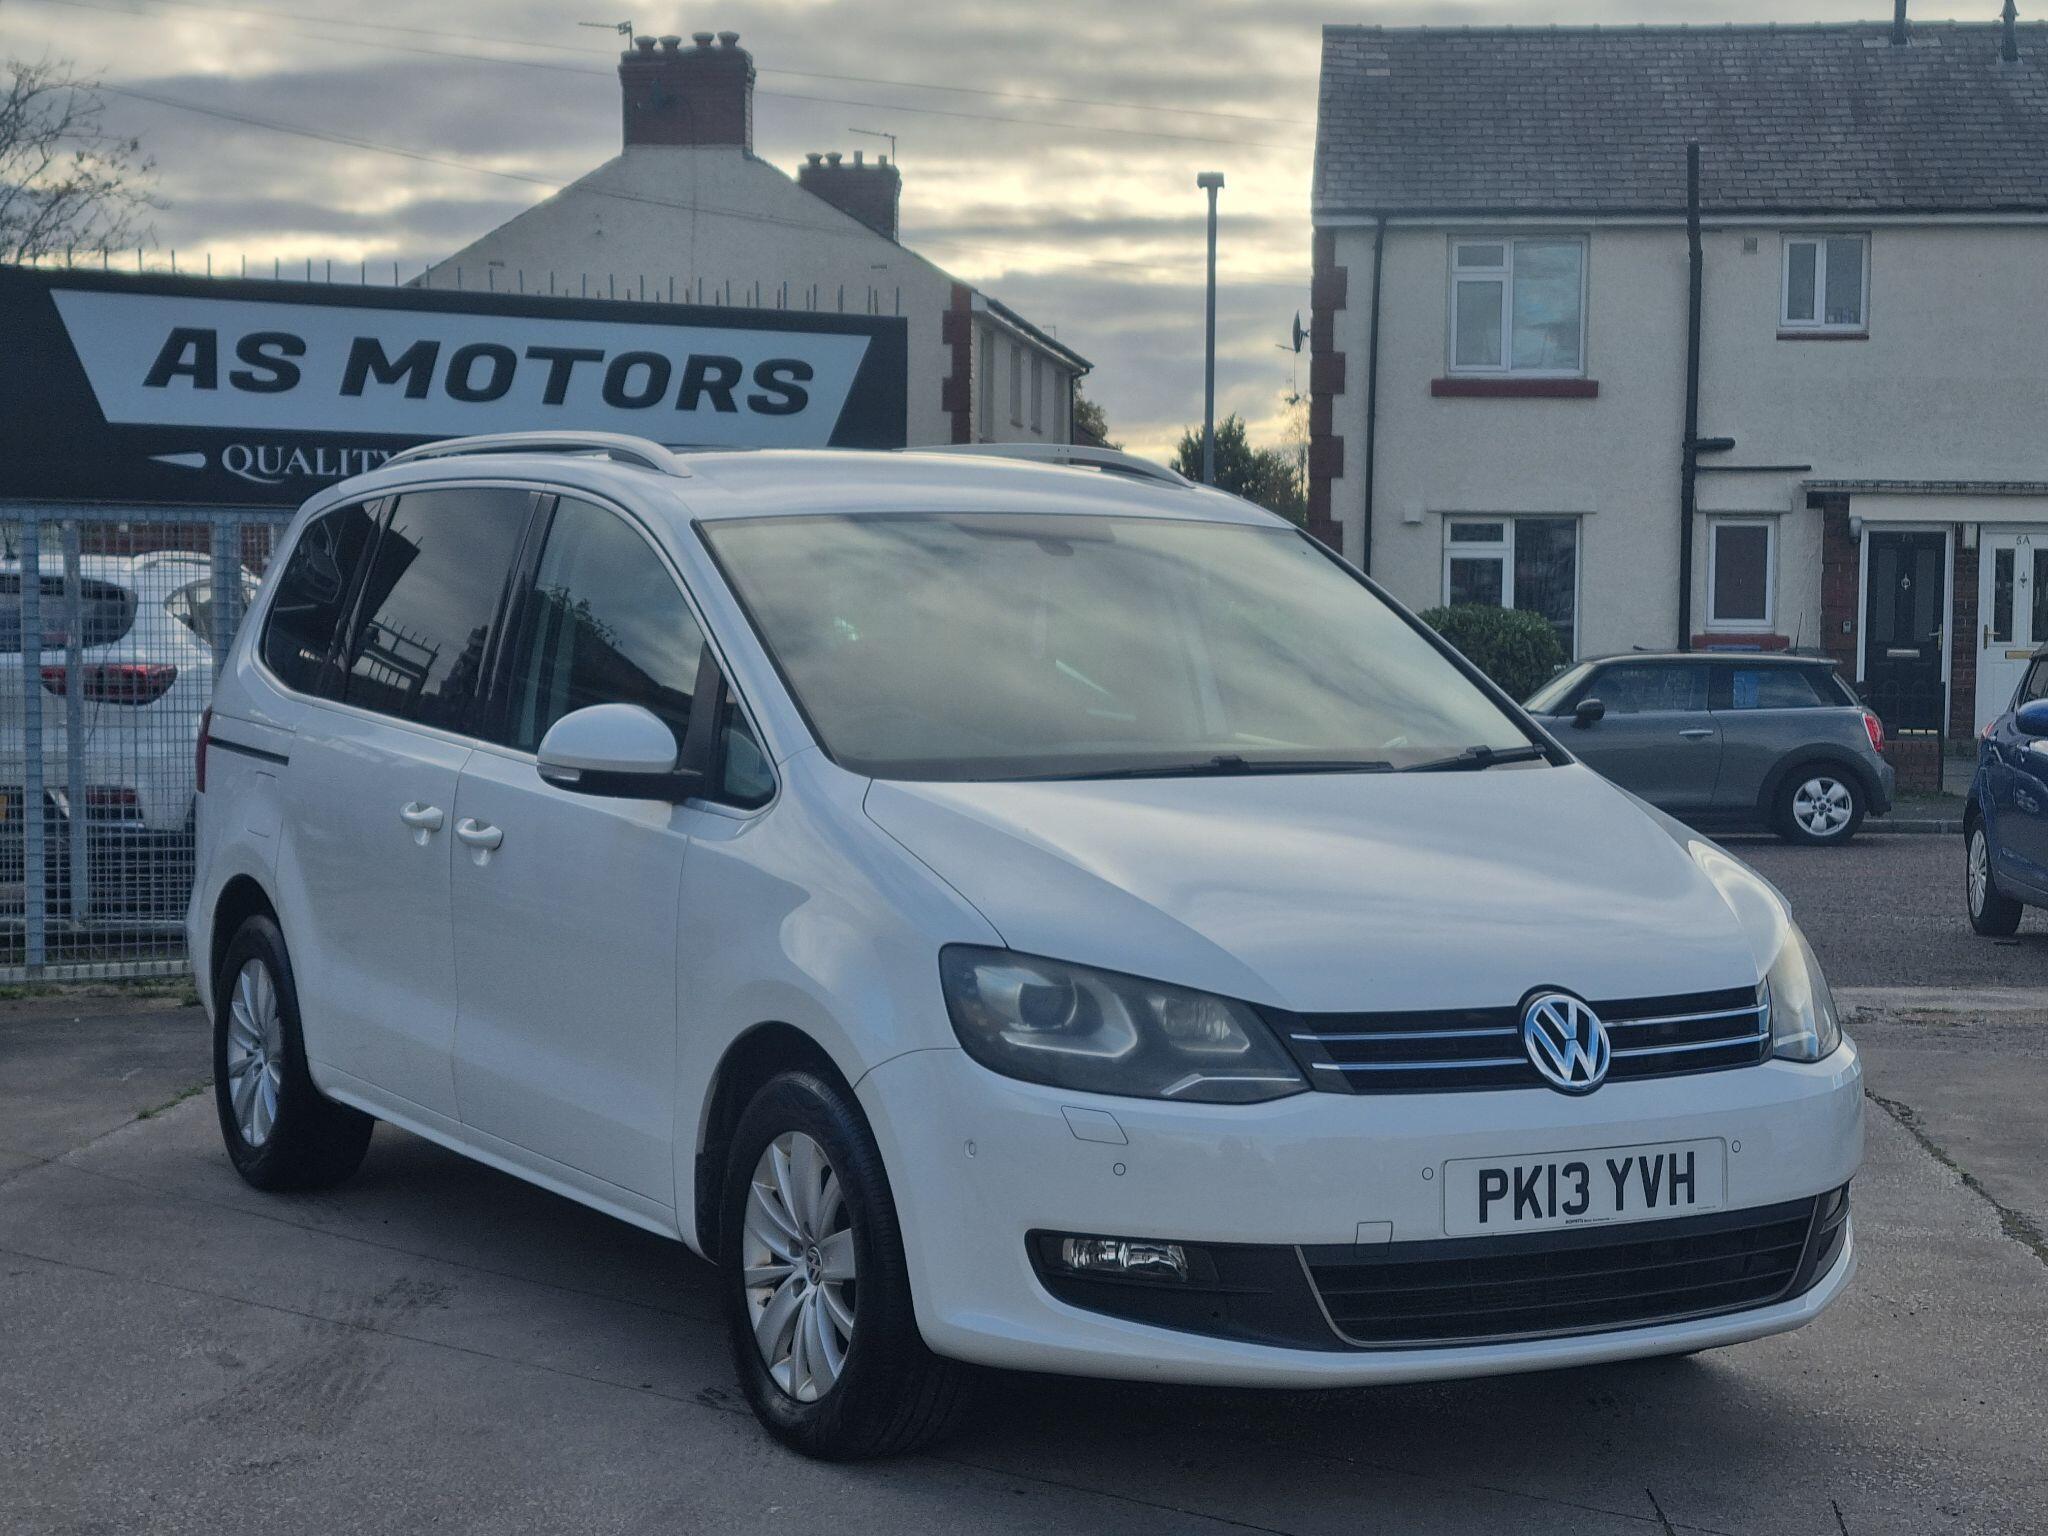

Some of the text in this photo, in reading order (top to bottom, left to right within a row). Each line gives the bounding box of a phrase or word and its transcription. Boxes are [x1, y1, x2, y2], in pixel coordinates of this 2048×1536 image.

[142, 327, 815, 416] AS MOTORS
[1478, 1151, 1696, 1224] PK13 YVH
